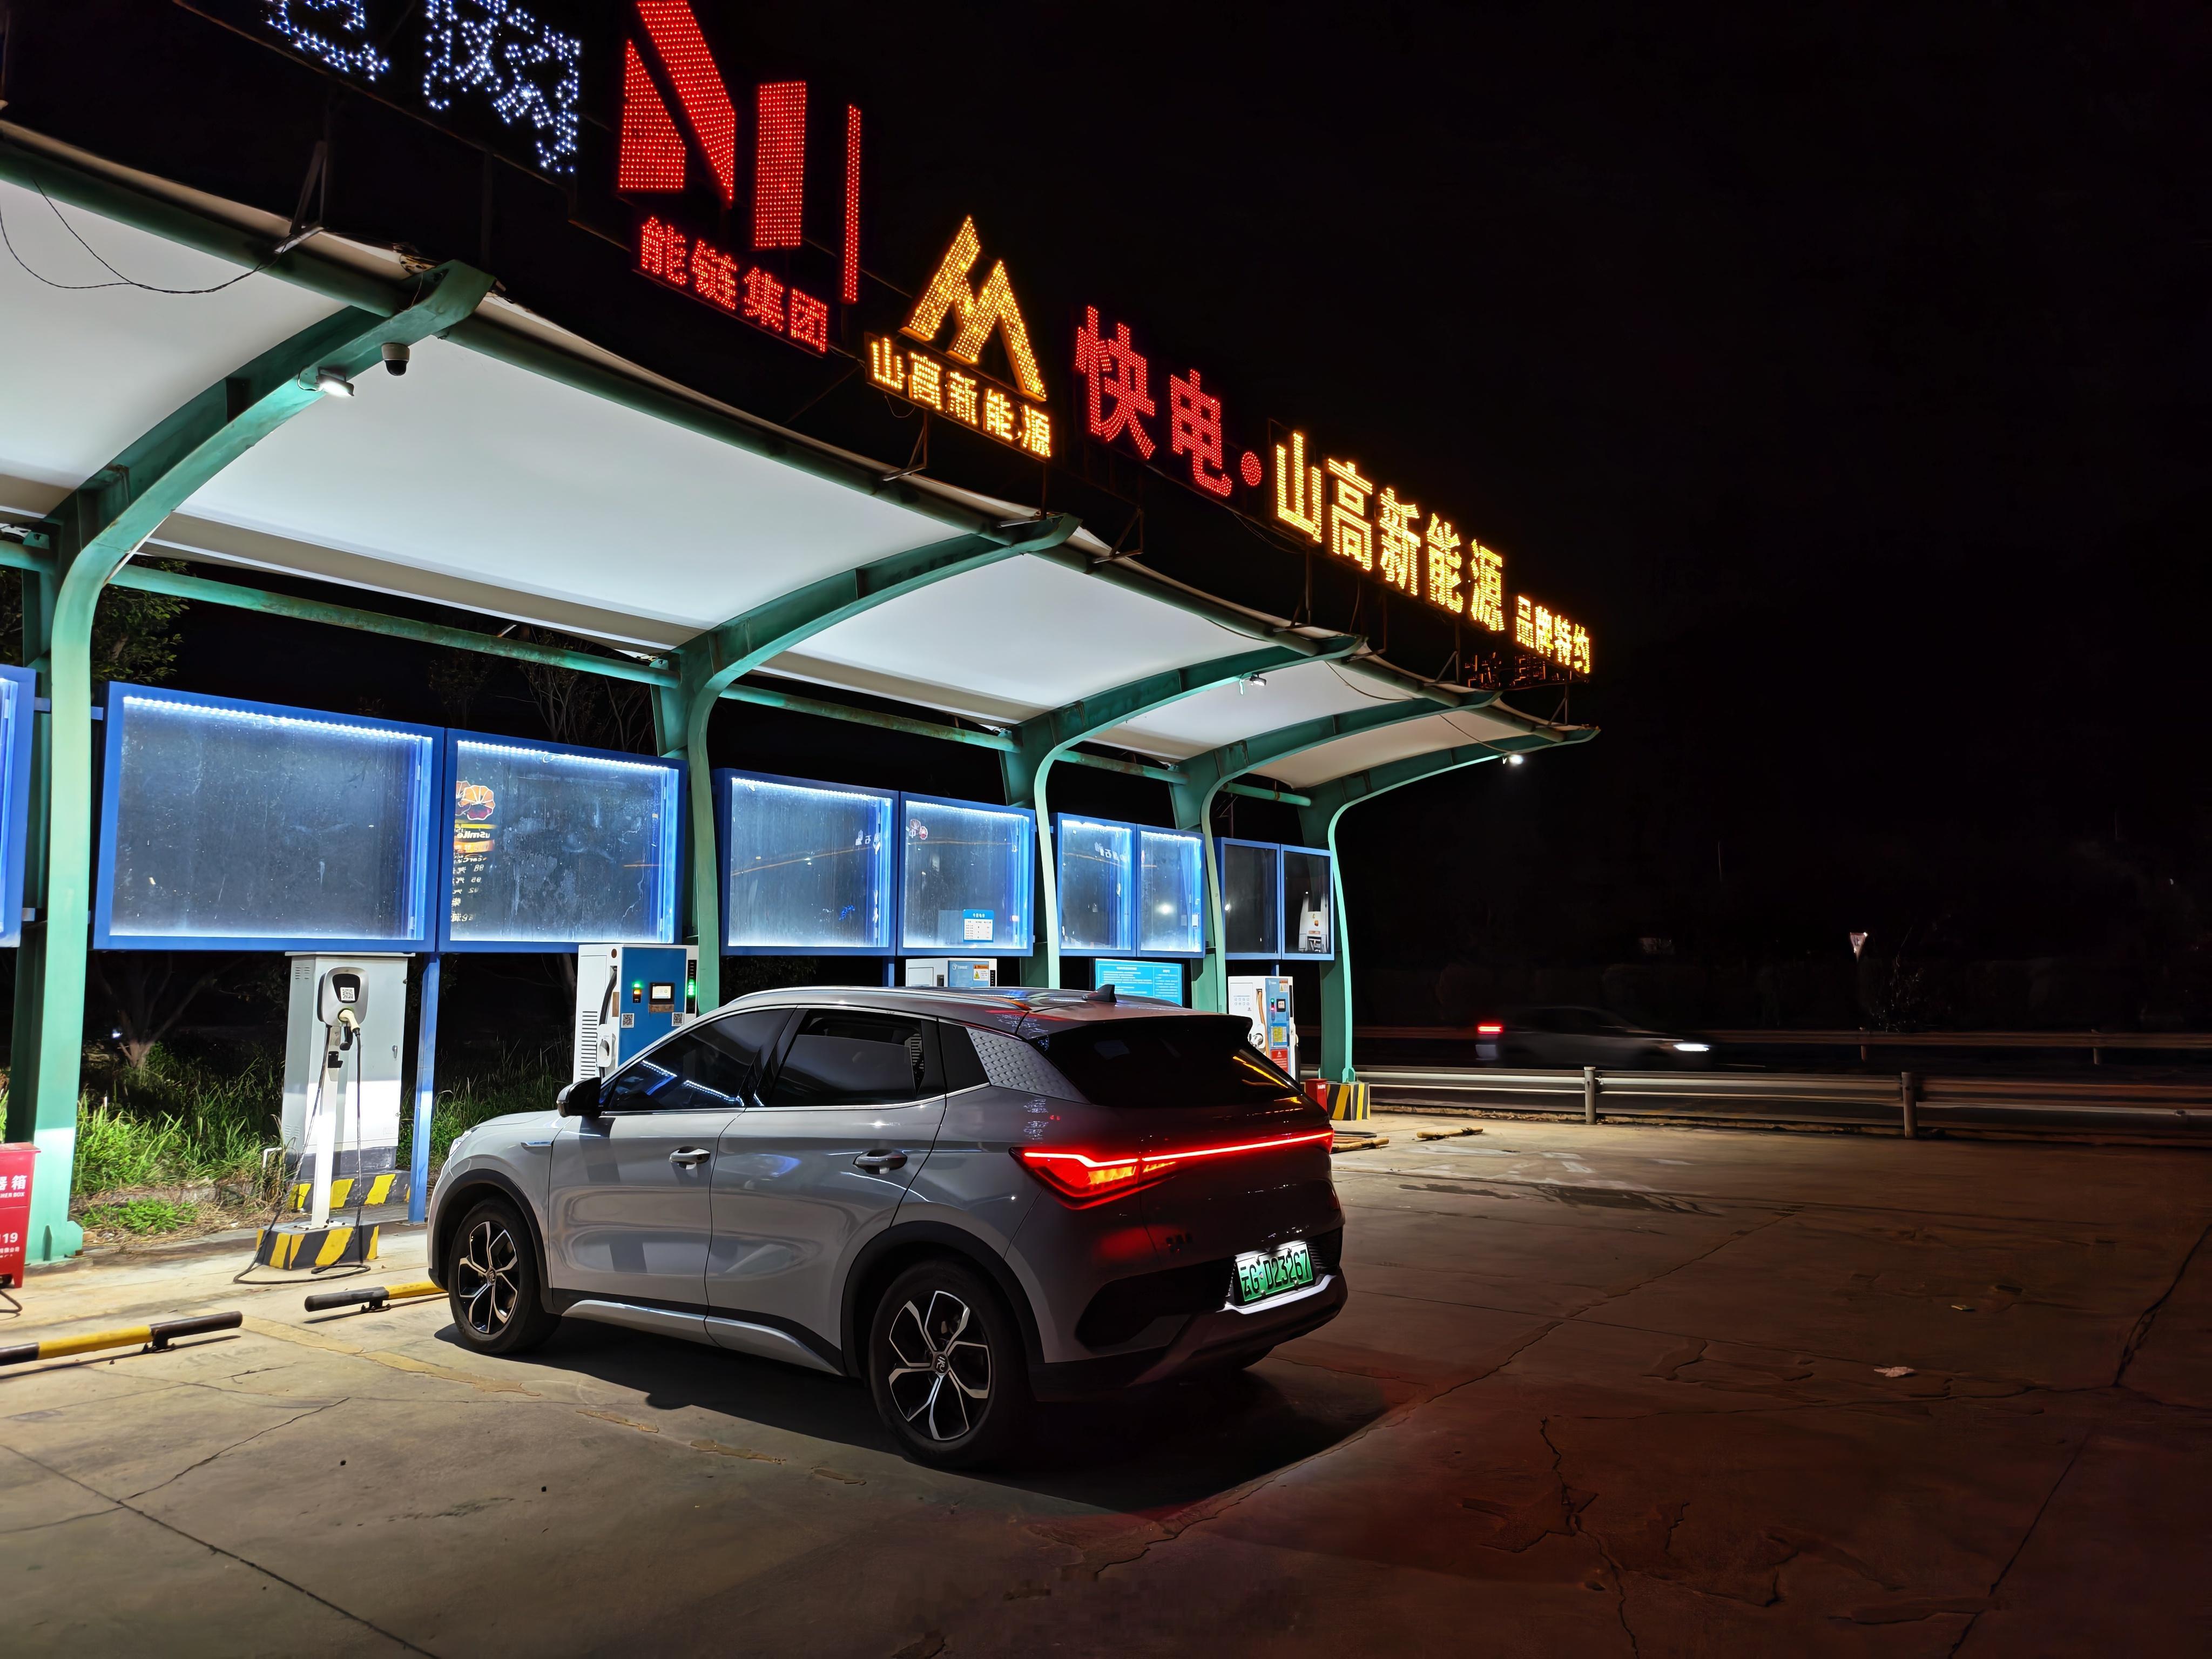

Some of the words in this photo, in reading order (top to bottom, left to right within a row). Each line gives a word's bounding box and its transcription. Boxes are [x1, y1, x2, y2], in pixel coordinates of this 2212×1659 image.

[640, 216, 828, 353] 能链集团
[870, 336, 1052, 458] 山高新能源
[0, 1232, 18, 1244] 19
